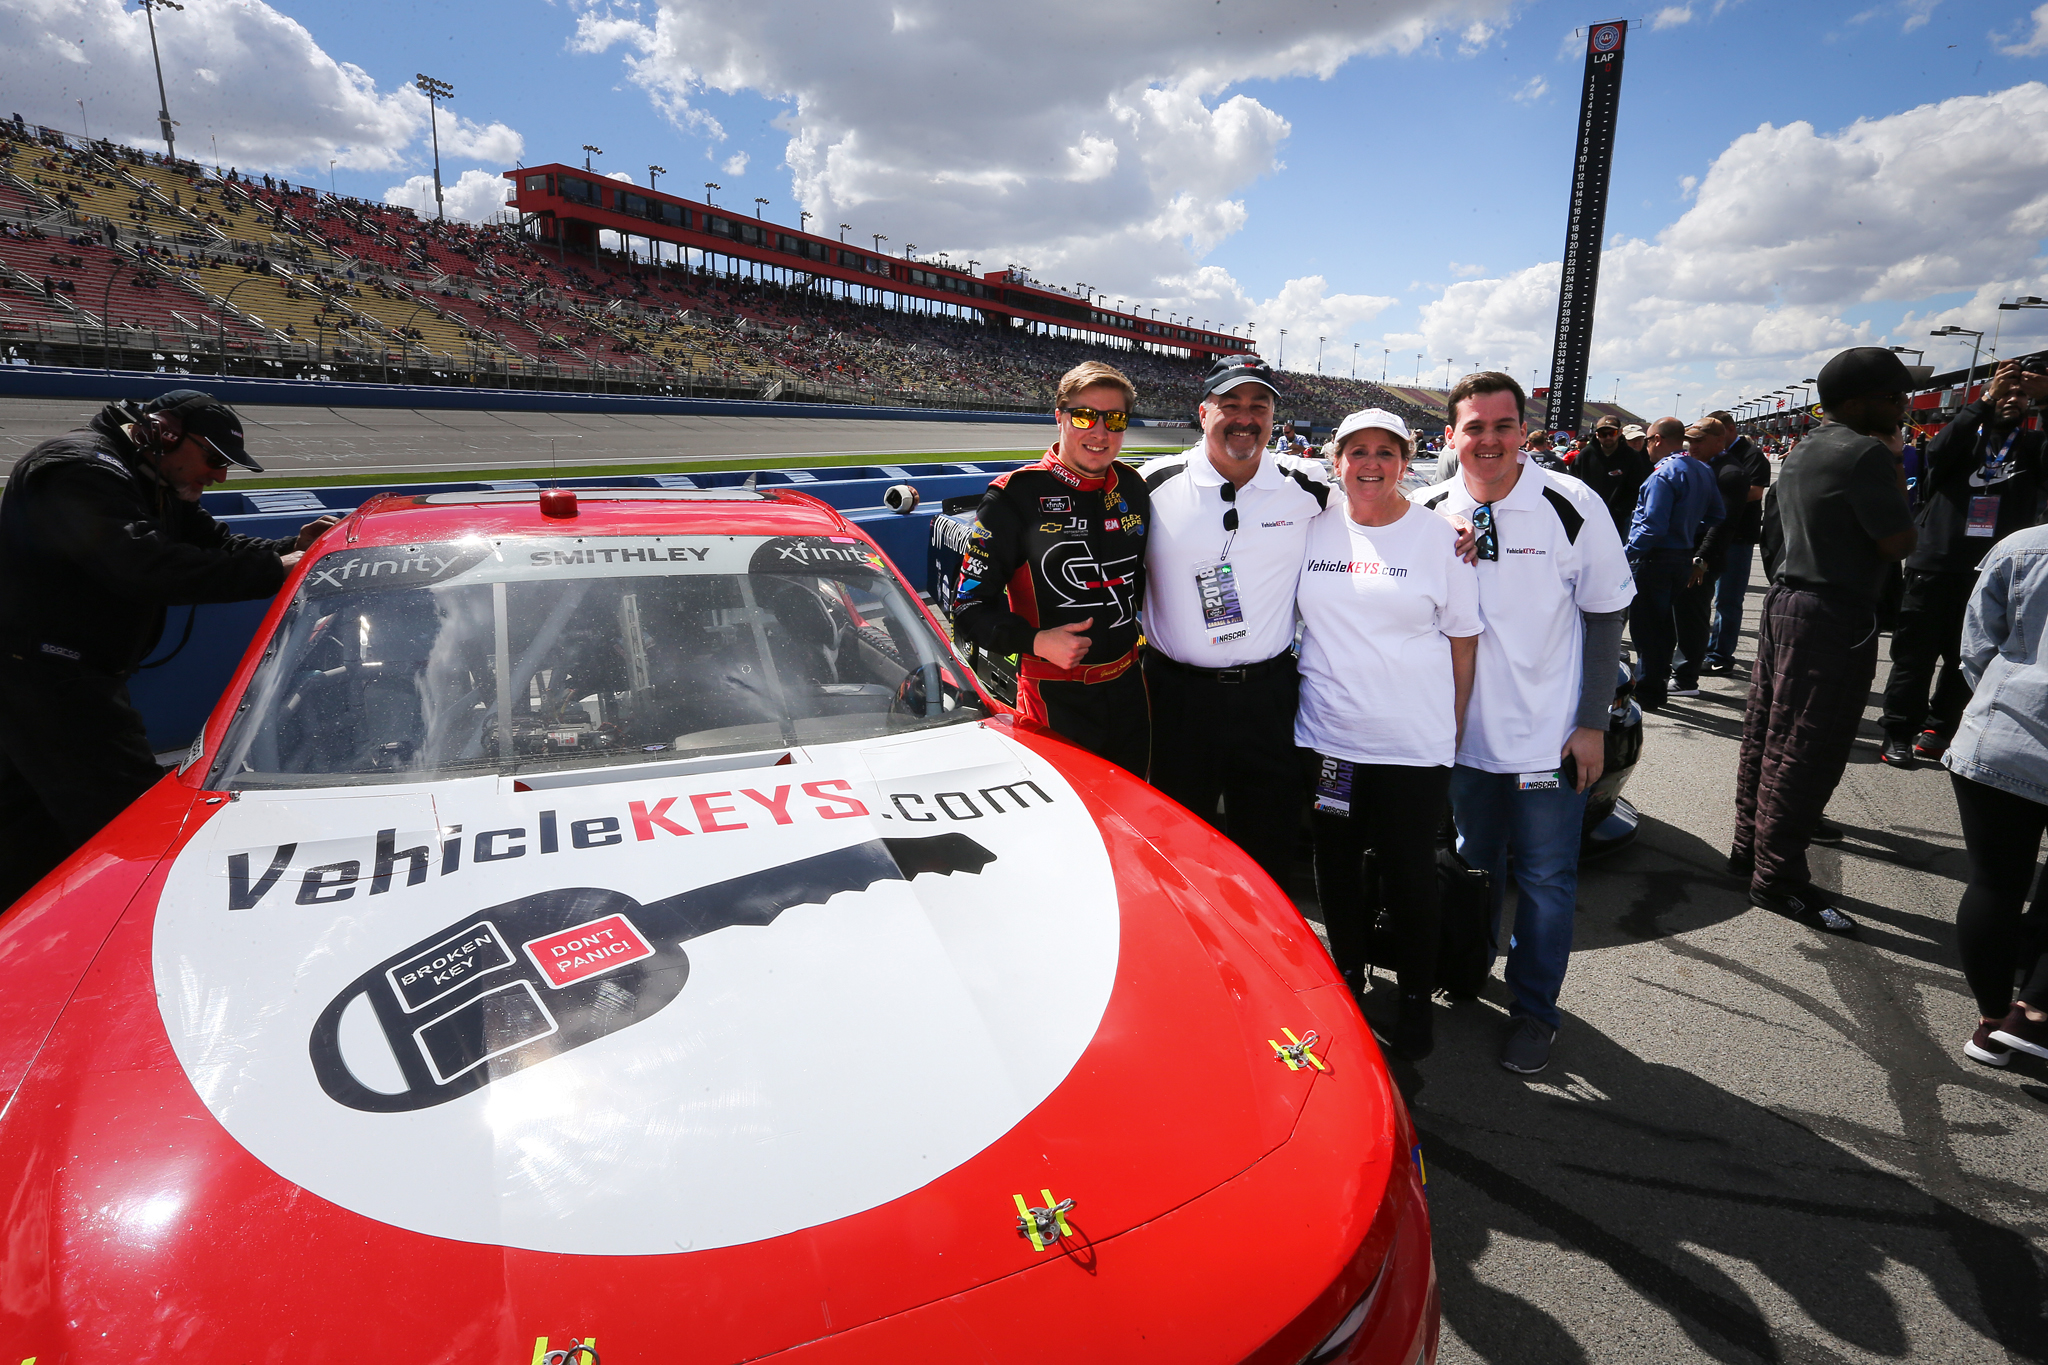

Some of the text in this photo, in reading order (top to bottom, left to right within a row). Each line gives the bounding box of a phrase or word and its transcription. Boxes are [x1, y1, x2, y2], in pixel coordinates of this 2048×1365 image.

[1594, 53, 1615, 64] LAP
[1605, 63, 1612, 72] 0
[1590, 75, 1596, 83] 1
[1589, 83, 1595, 92] 2
[1588, 92, 1594, 101] 3
[1587, 101, 1593, 109] 4
[1586, 110, 1592, 119] 5
[1585, 119, 1591, 128] 6
[1585, 128, 1590, 136] 7
[1583, 137, 1589, 145] 8
[1582, 146, 1589, 154] 9
[1577, 173, 1585, 181] 12
[1574, 199, 1582, 207] 15
[1572, 216, 1580, 224] 17
[1570, 233, 1579, 241] 19
[1569, 242, 1579, 250] 20
[1567, 259, 1577, 267] 22
[1566, 267, 1576, 275] 23
[1564, 284, 1574, 292] 25
[1563, 292, 1573, 300] 26
[1561, 309, 1571, 317] 28
[1560, 317, 1570, 325] 29
[1559, 325, 1570, 333] 30
[1557, 350, 1567, 358] 33
[1556, 358, 1566, 366] 34
[1555, 366, 1565, 374] 35
[1046, 501, 1066, 510] xfinity
[1120, 514, 1142, 526] FLEX
[1506, 547, 1546, 555] VehicleKEYS.com
[530, 547, 711, 568] SMITHLEY
[314, 553, 460, 588] xfinity
[1307, 559, 1408, 578] VehicleKEYS.com
[1200, 566, 1223, 608] 2018
[1219, 630, 1246, 643] NASCAR
[1321, 755, 1338, 780] 20
[1528, 781, 1558, 789] NASCAR
[228, 779, 1055, 911] VehicleKEYS.com
[550, 928, 615, 958] DON'T
[400, 933, 494, 987] BROKEN
[556, 940, 632, 973] PANIC!
[433, 956, 475, 986] KEY
